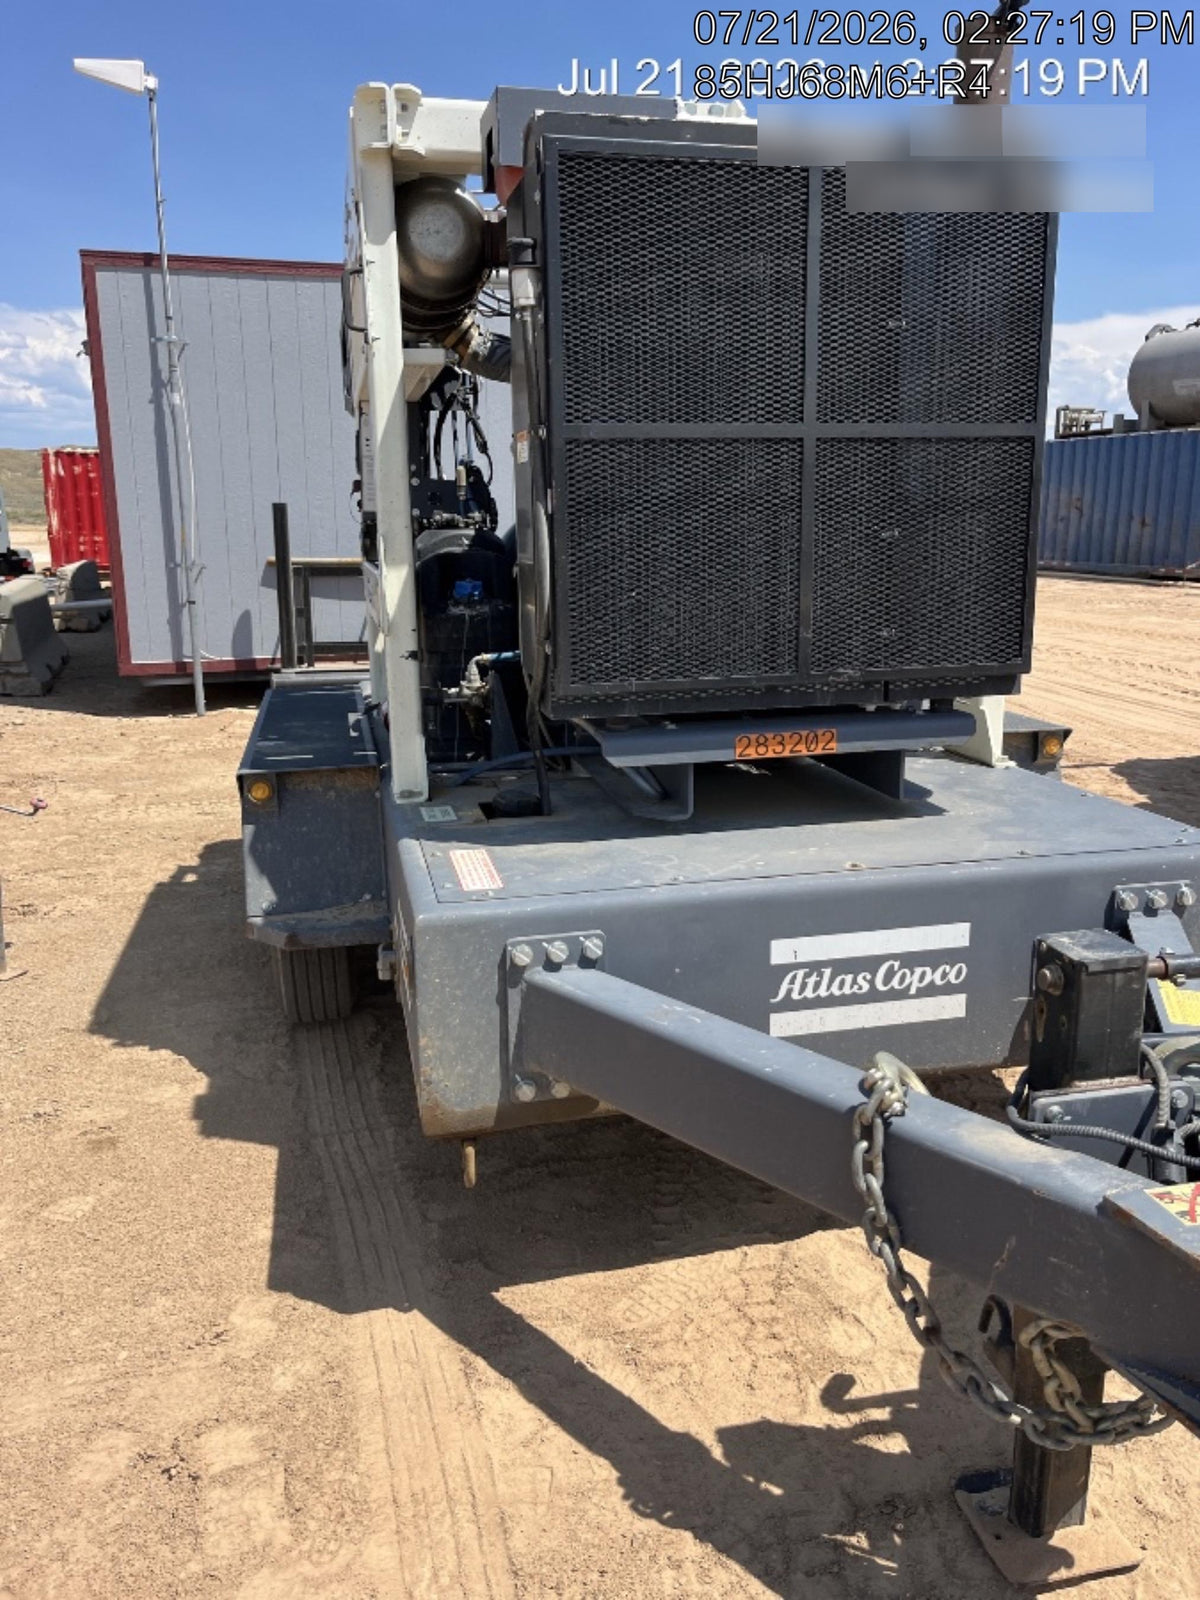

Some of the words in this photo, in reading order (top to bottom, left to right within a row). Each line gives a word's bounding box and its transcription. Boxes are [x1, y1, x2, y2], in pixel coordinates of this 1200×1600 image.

[737, 730, 835, 758] 283202
[769, 966, 871, 1003] Atlas
[874, 960, 968, 994] Copco
